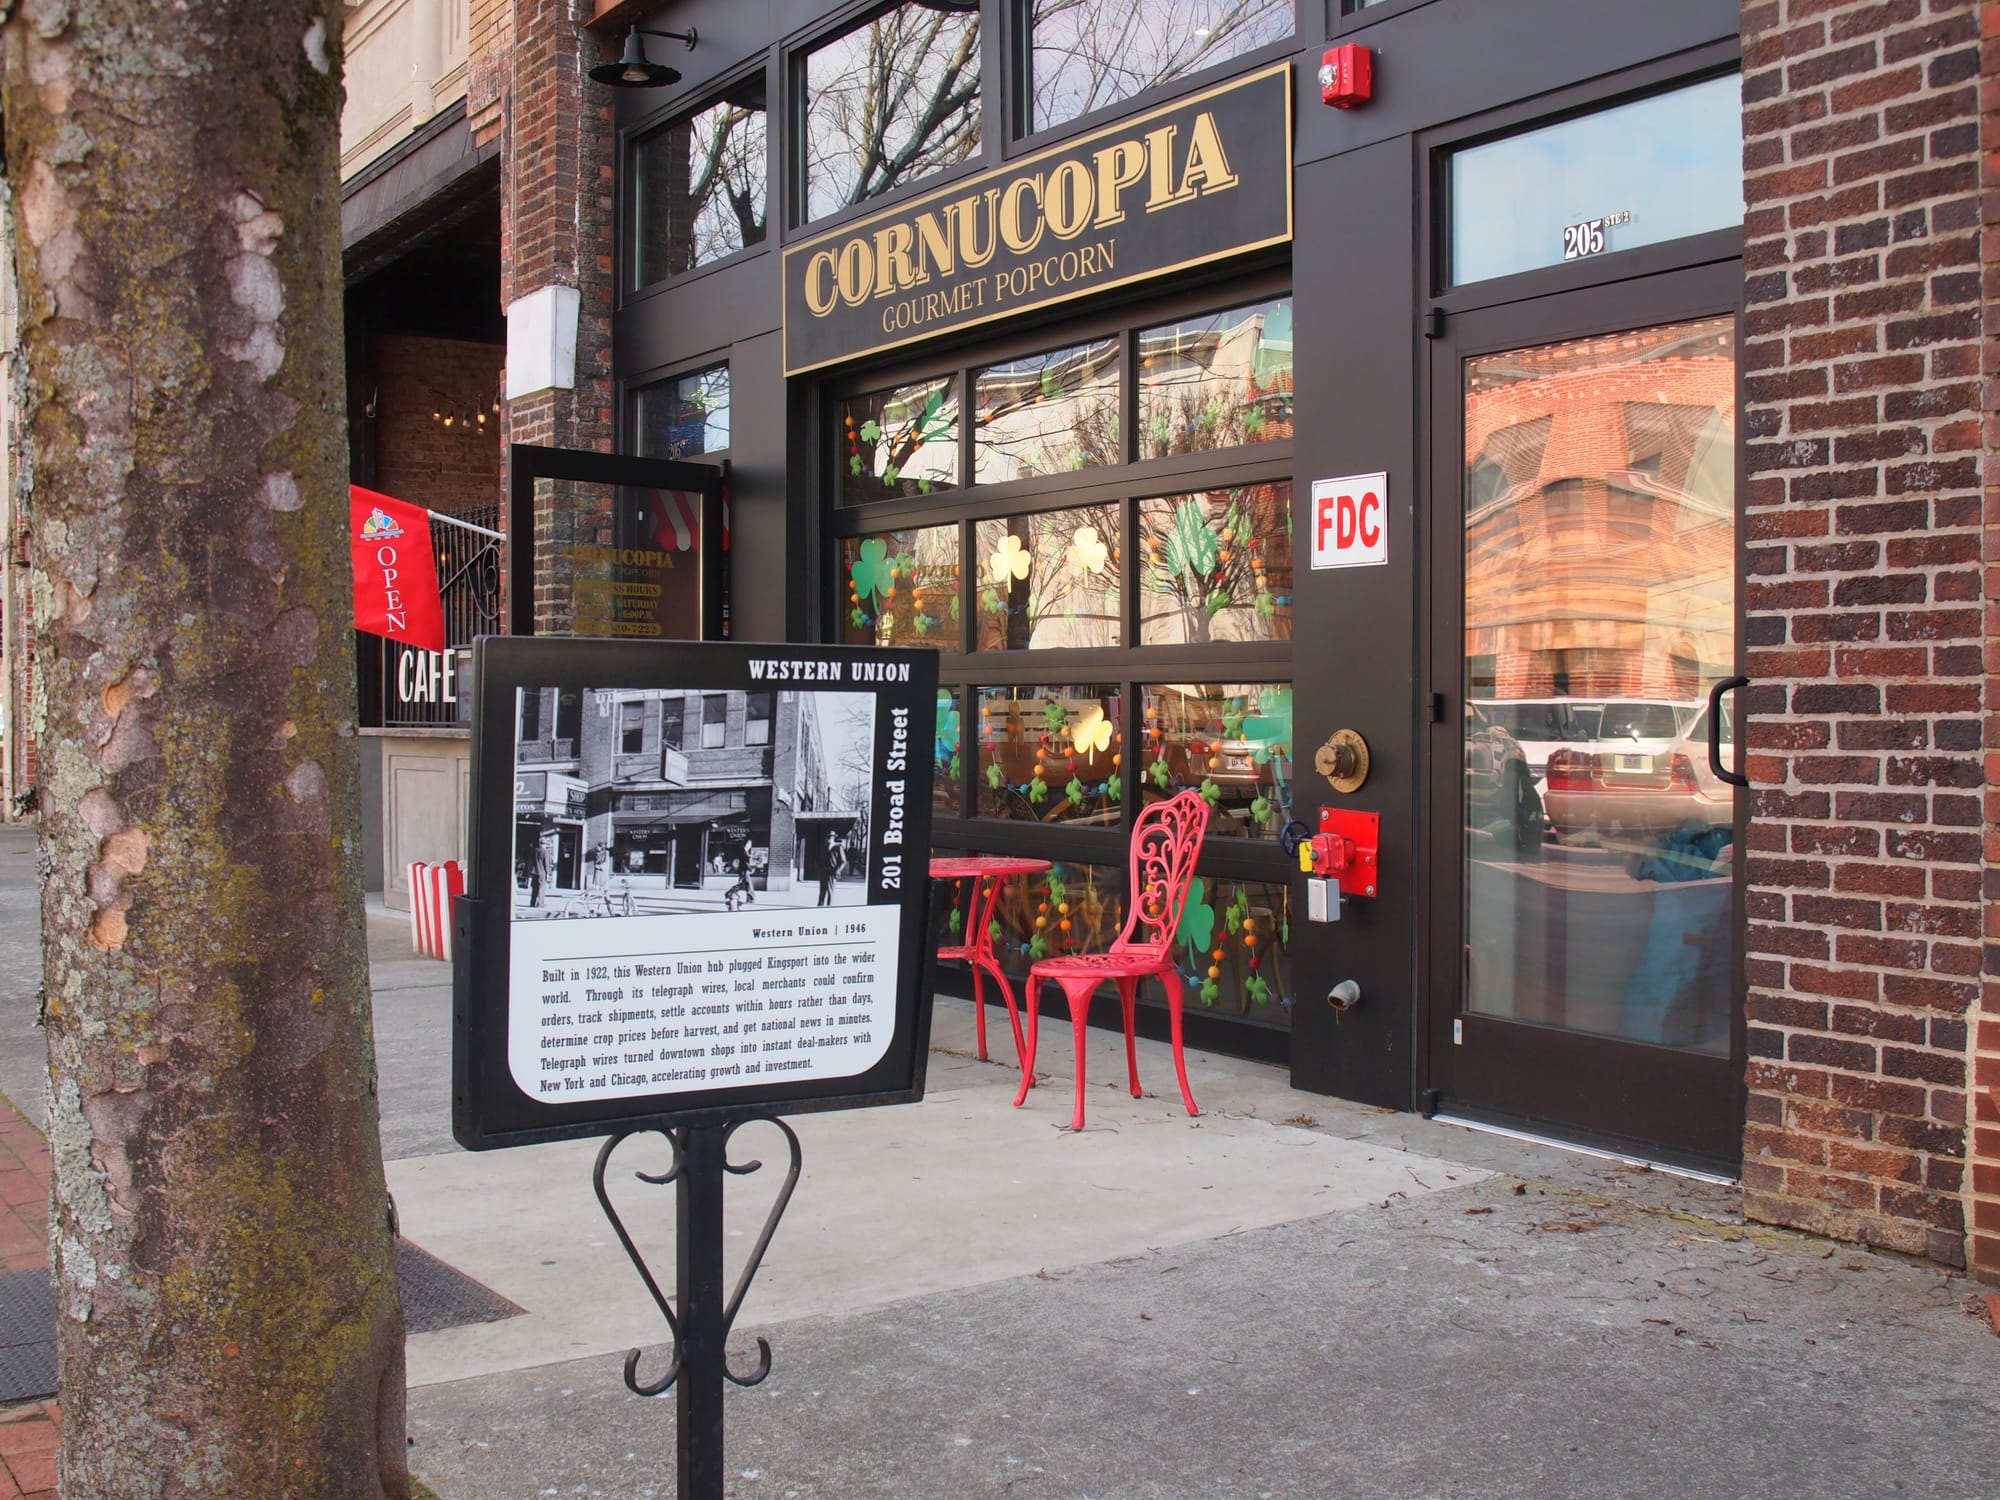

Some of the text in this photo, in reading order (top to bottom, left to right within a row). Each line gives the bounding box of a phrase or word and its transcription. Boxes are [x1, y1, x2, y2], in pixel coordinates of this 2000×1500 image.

[804, 111, 1239, 319] CORNUCOPIA
[1564, 211, 1630, 260] 205 STE 2
[882, 239, 1116, 334] GOURMET POPCORN
[1318, 491, 1380, 551] FDC
[377, 545, 407, 633] OPEN
[626, 585, 658, 595] HOURS
[398, 648, 457, 703] CAFE
[748, 659, 911, 682] WESTERN UNION
[881, 707, 909, 890] 201 Broad Street
[753, 928, 793, 938] Western
[798, 926, 828, 936] Union
[845, 923, 866, 933] 1946
[542, 952, 876, 983] Built in 1922, this Western Union hub plugged Kingsport into the wider
[542, 972, 874, 1005] world. Through its telegraph wires, local merchants could confirm
[541, 991, 874, 1027] orders, track shipments, settle accounts within hours rather than days,
[541, 1012, 873, 1049] determine crop prices before harvest, and get national news in minutes.
[540, 1032, 872, 1072] Telegraph wires turned downtown shops into instant deal-makers with
[540, 1058, 814, 1093] New York and Chicago, accelerating growth and investment.
